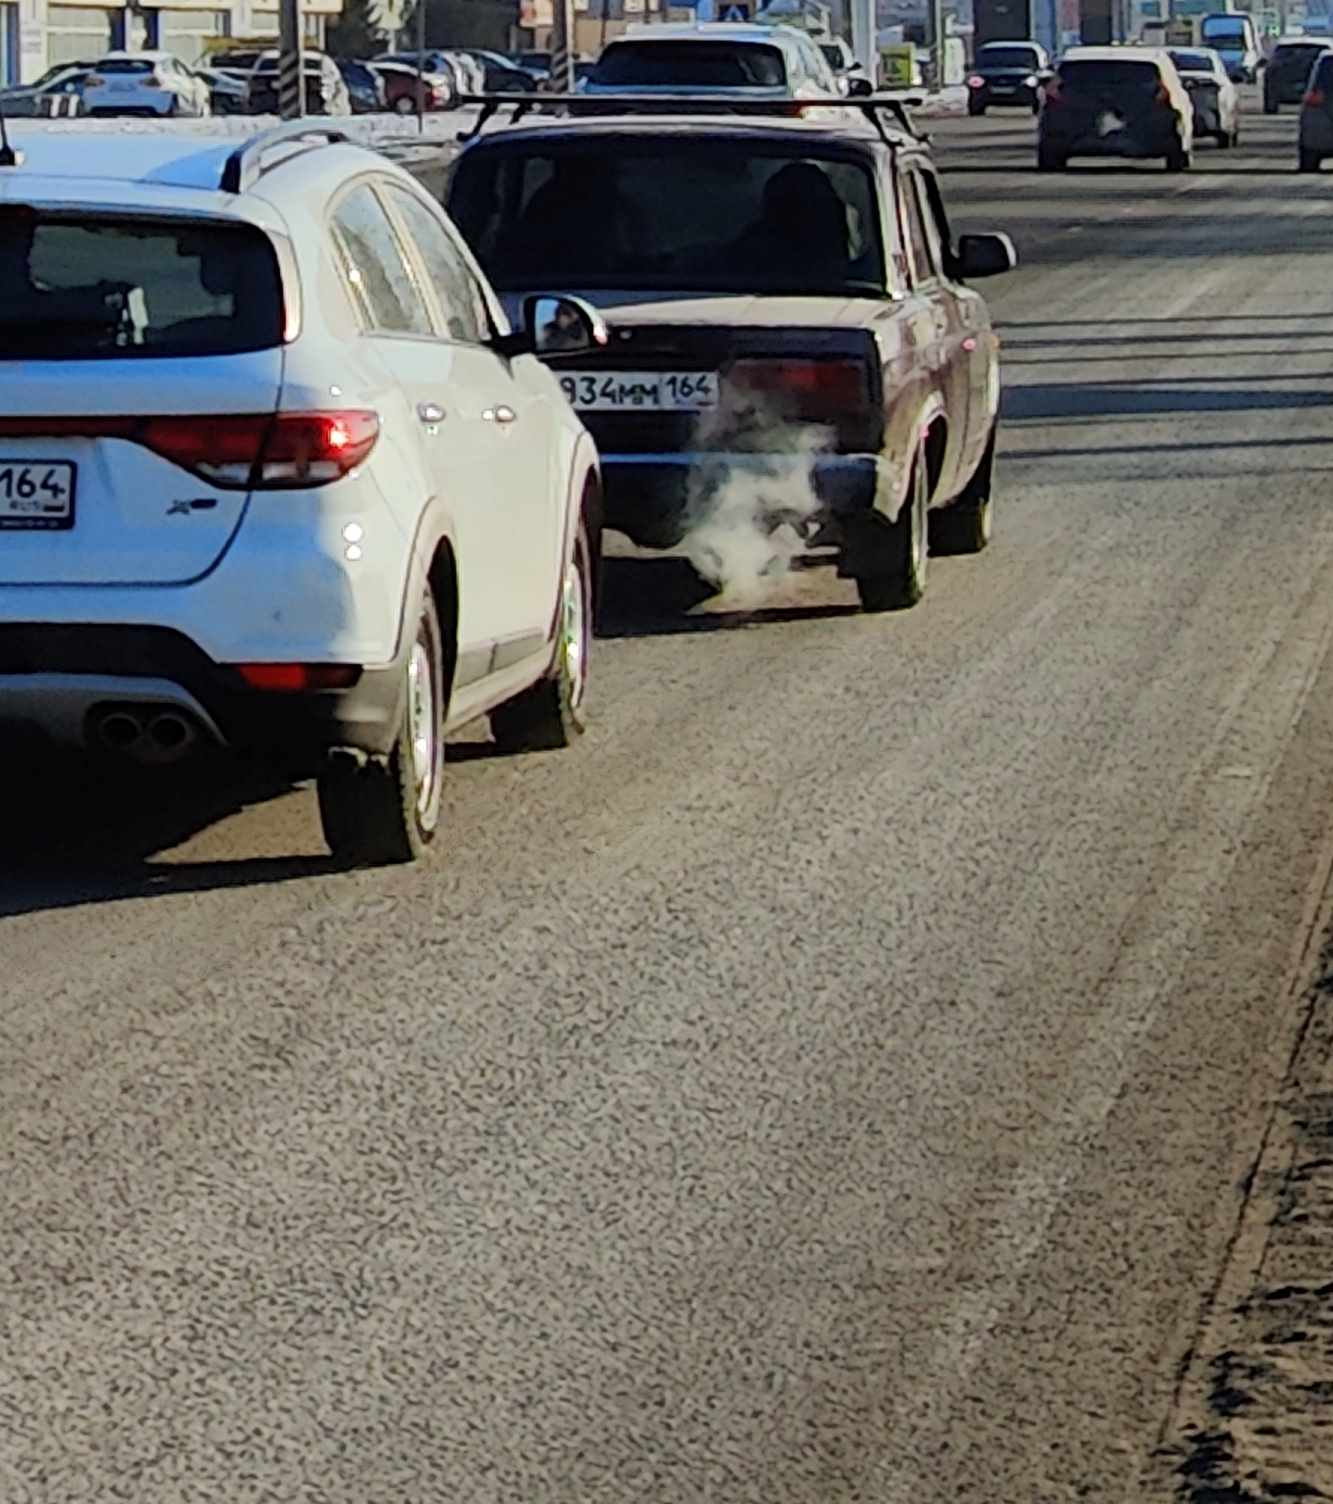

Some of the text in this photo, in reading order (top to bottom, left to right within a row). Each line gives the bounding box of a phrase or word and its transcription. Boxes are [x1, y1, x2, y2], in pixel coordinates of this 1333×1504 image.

[560, 375, 712, 404] 934ММ 164
[0, 468, 66, 498] 164
